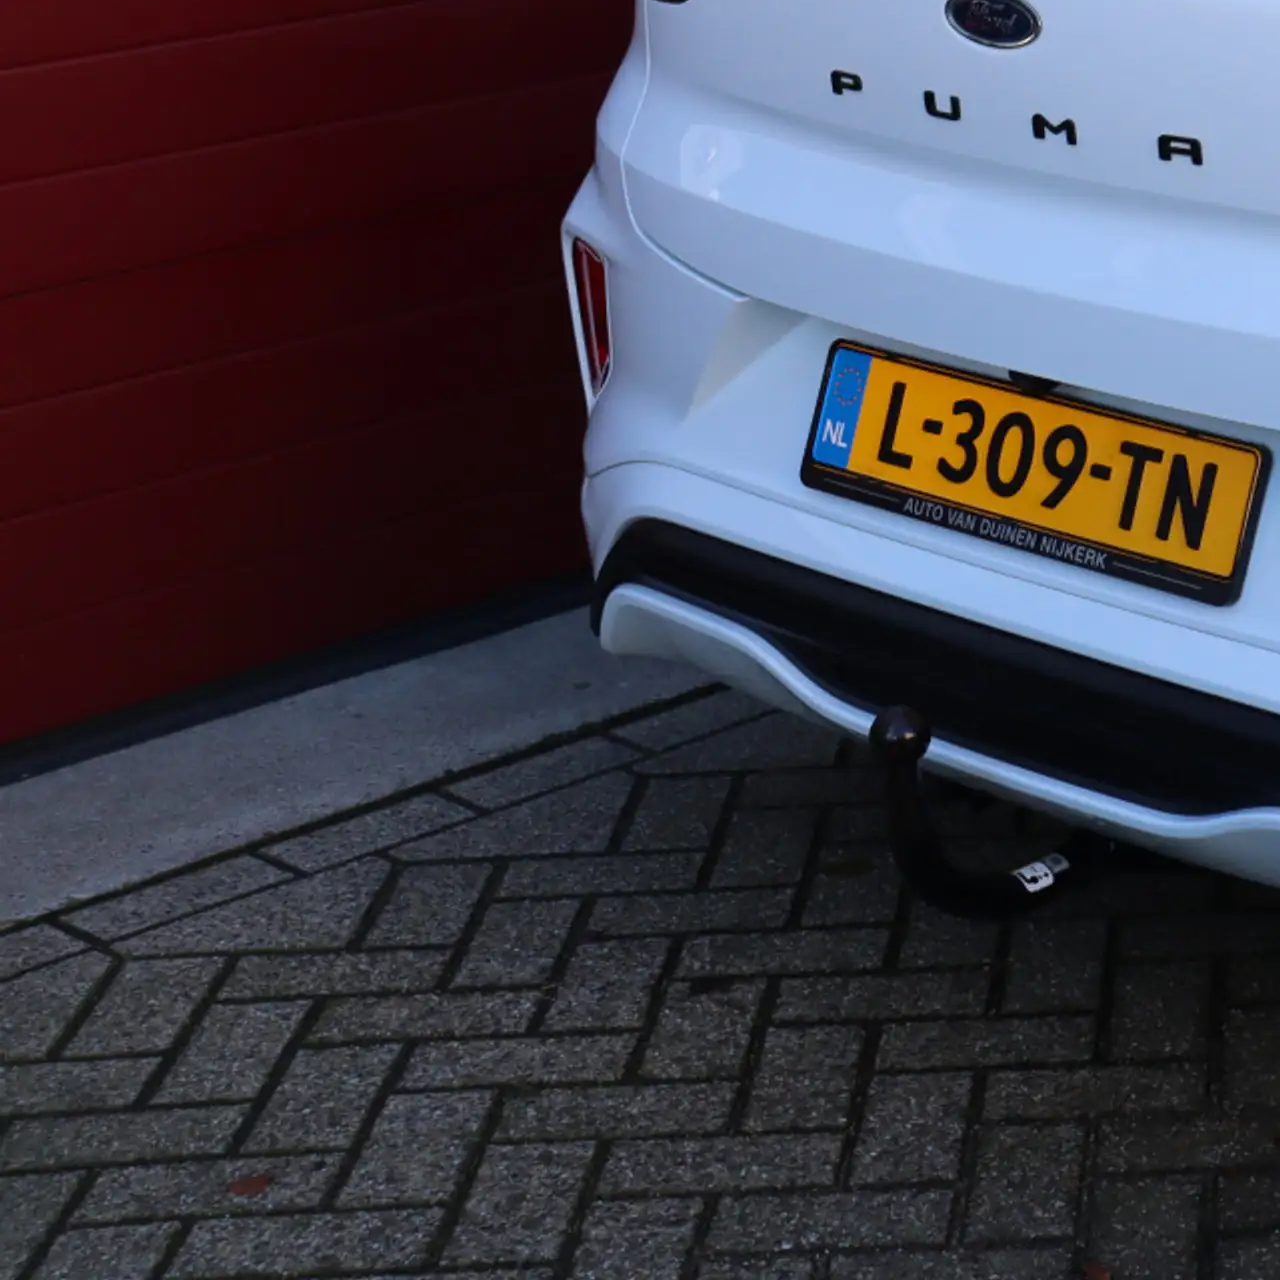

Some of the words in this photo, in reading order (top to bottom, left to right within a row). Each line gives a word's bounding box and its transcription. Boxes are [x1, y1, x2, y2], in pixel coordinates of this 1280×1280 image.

[830, 68, 1204, 166] PUMA
[822, 418, 848, 449] NL
[876, 381, 1219, 551] L-309-TN
[902, 496, 945, 523] AUTO
[946, 507, 977, 532] VAN
[978, 516, 1038, 550] DUINEN
[1039, 533, 1108, 570] NIJKERK
